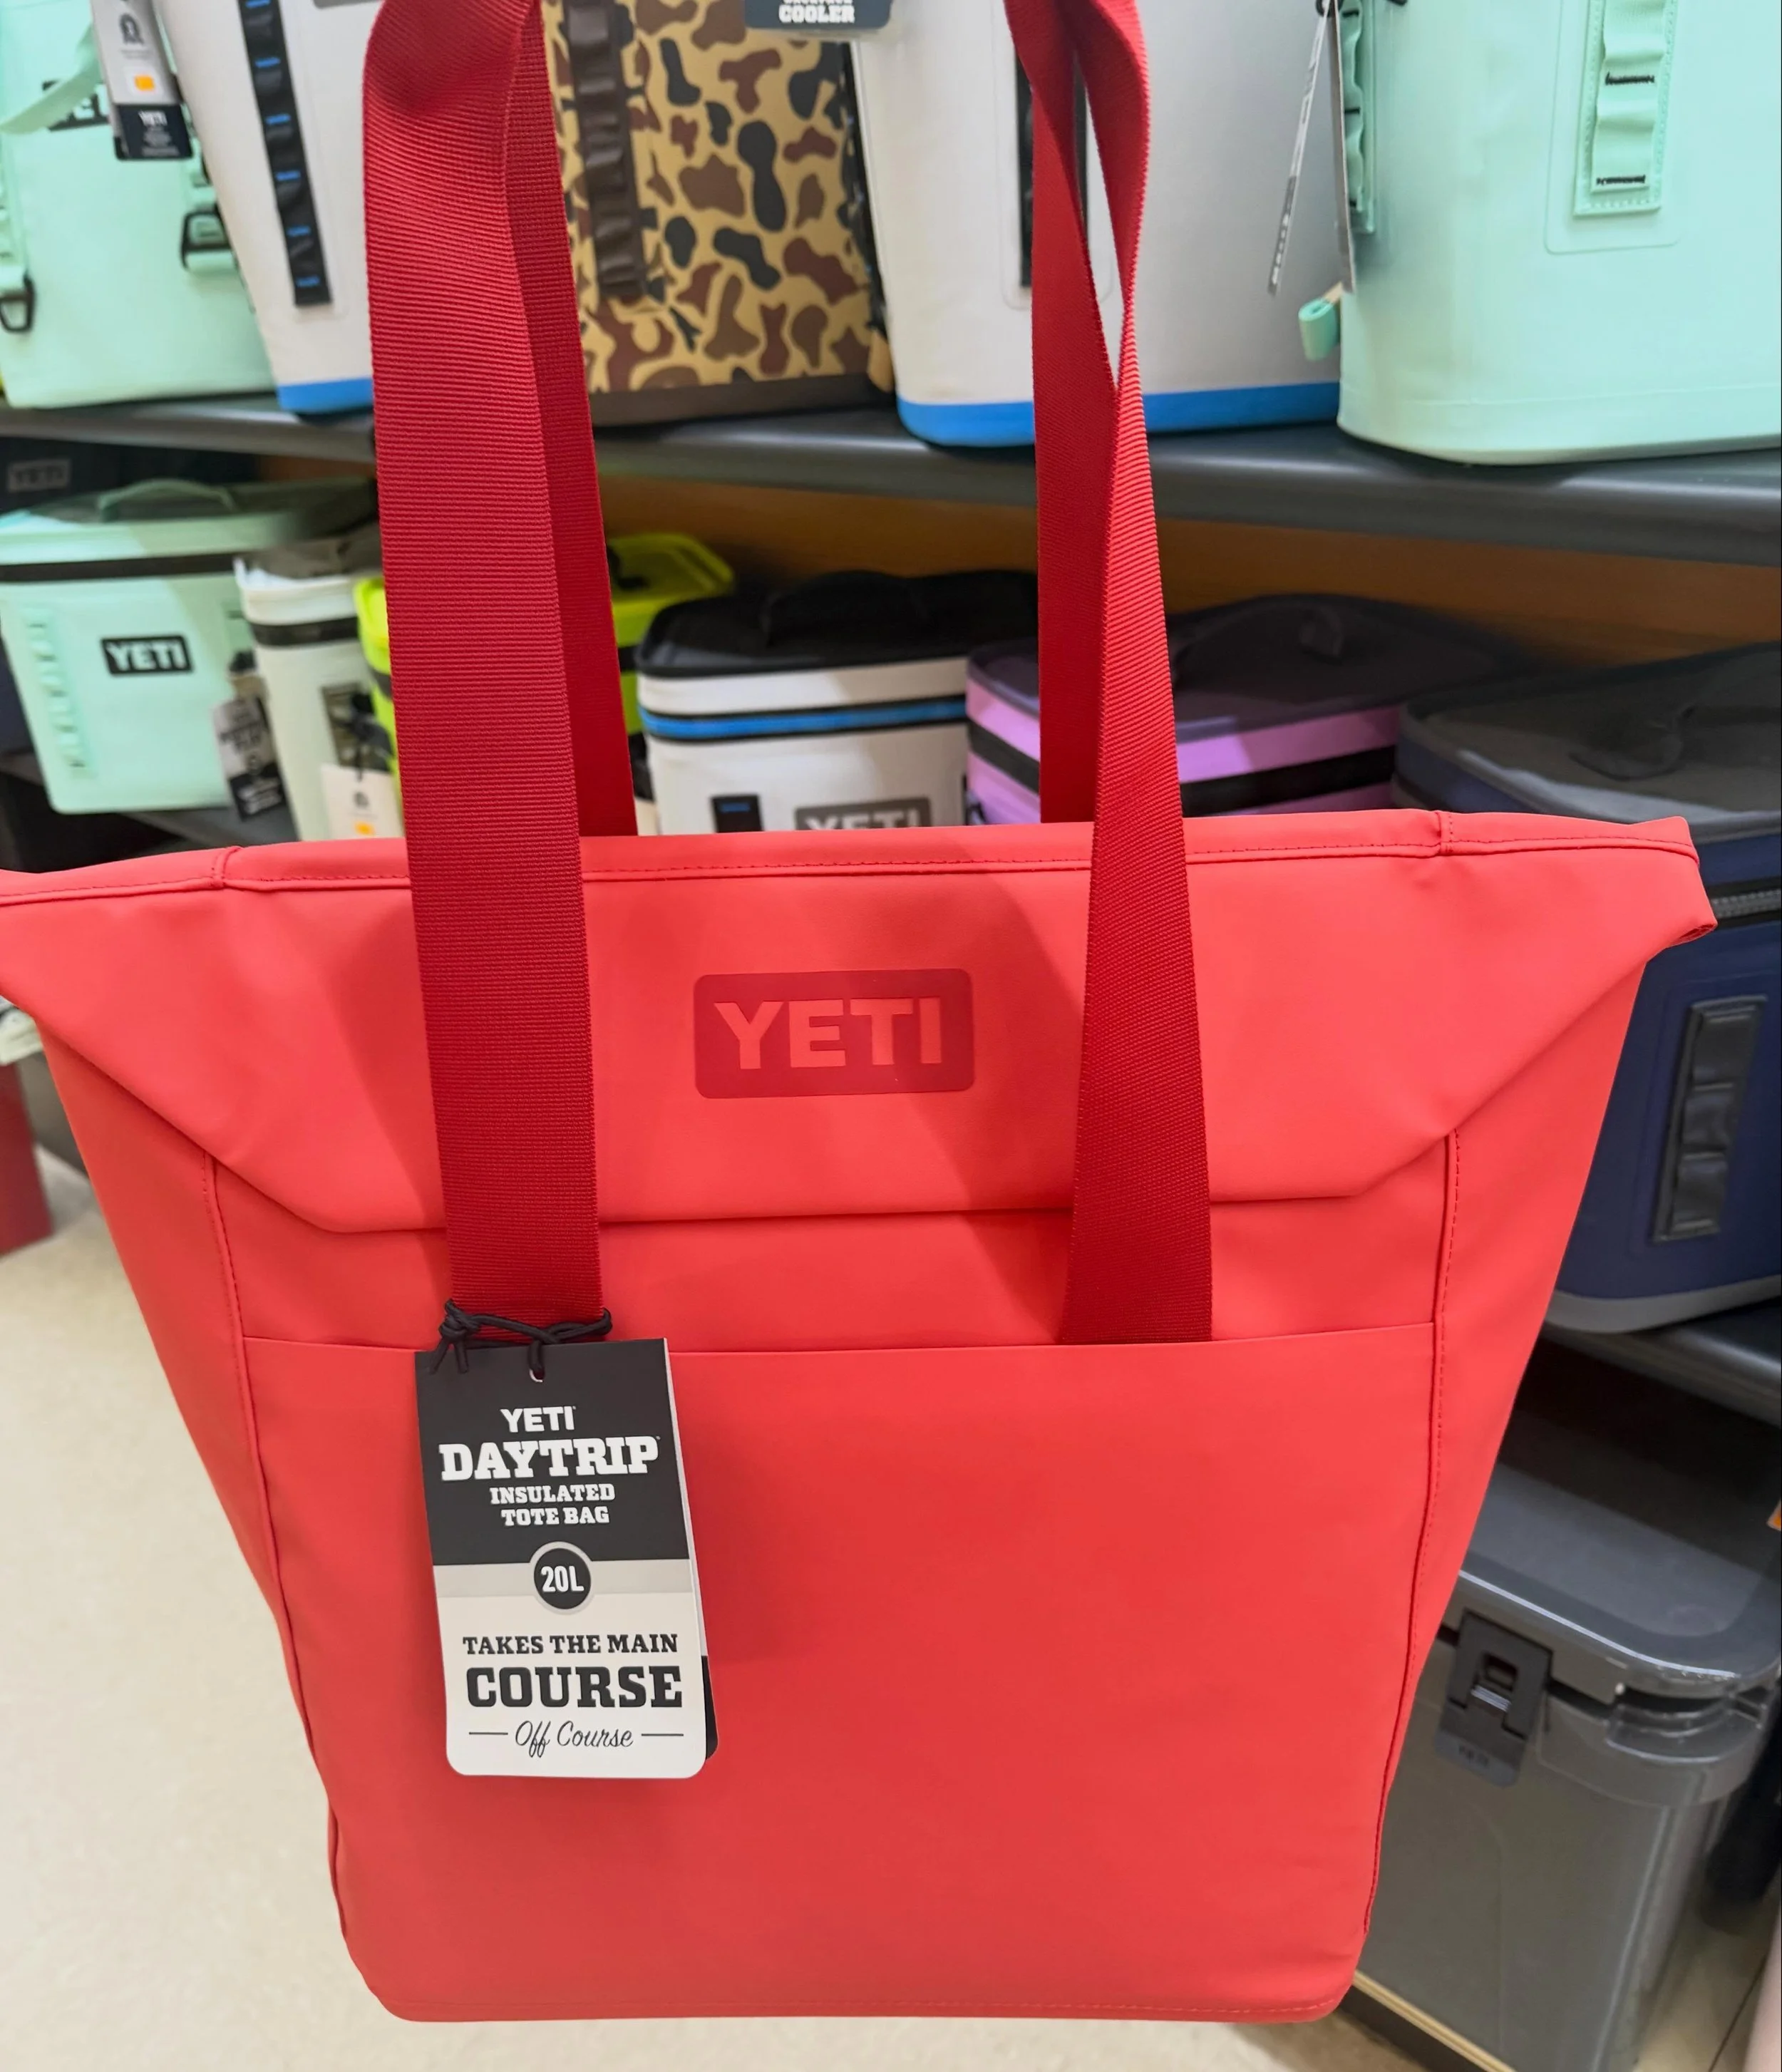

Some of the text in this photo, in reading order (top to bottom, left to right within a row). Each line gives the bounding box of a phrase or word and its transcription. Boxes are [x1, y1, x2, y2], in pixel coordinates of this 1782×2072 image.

[778, 4, 855, 24] COOLER
[105, 641, 186, 671] YETI
[714, 997, 942, 1070] YETI
[500, 1406, 575, 1433] YETI
[438, 1436, 659, 1481] DAYTRIP
[489, 1483, 616, 1505] INSULATED
[501, 1506, 610, 1527] TOTE BAG
[540, 1565, 584, 1593] 20L
[463, 1634, 679, 1655] TAKES THE MAIN
[466, 1665, 683, 1708] COURSE
[515, 1720, 634, 1758] Off Course
